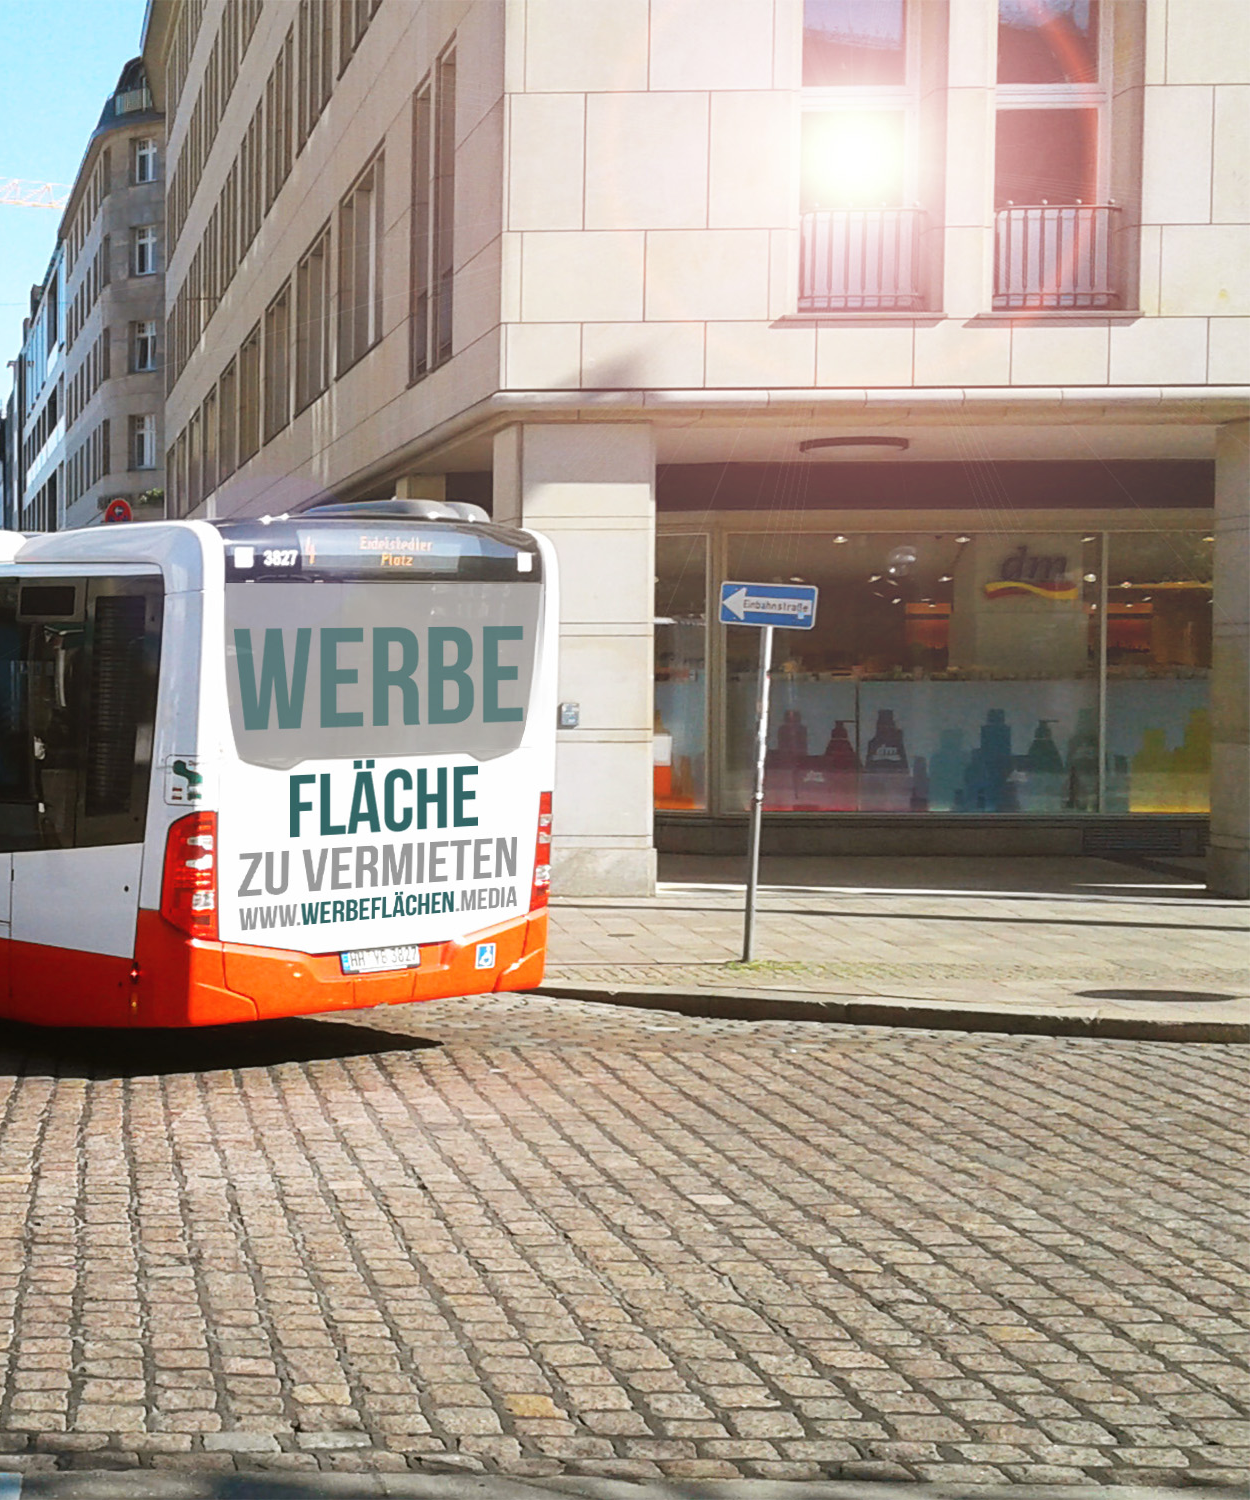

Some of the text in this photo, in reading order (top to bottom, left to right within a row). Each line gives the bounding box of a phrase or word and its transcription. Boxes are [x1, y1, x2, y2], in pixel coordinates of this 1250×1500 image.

[263, 549, 298, 567] 3827
[380, 553, 413, 566] Platz
[1001, 545, 1067, 579] dm
[743, 599, 809, 613] Einbahnstraße
[234, 626, 523, 730] WERBE
[290, 759, 478, 837] FLÄCHE
[238, 837, 517, 897] ZU VERMIETEN
[239, 886, 517, 930] WWW.WERBEFLÄCHEN.MEDIA
